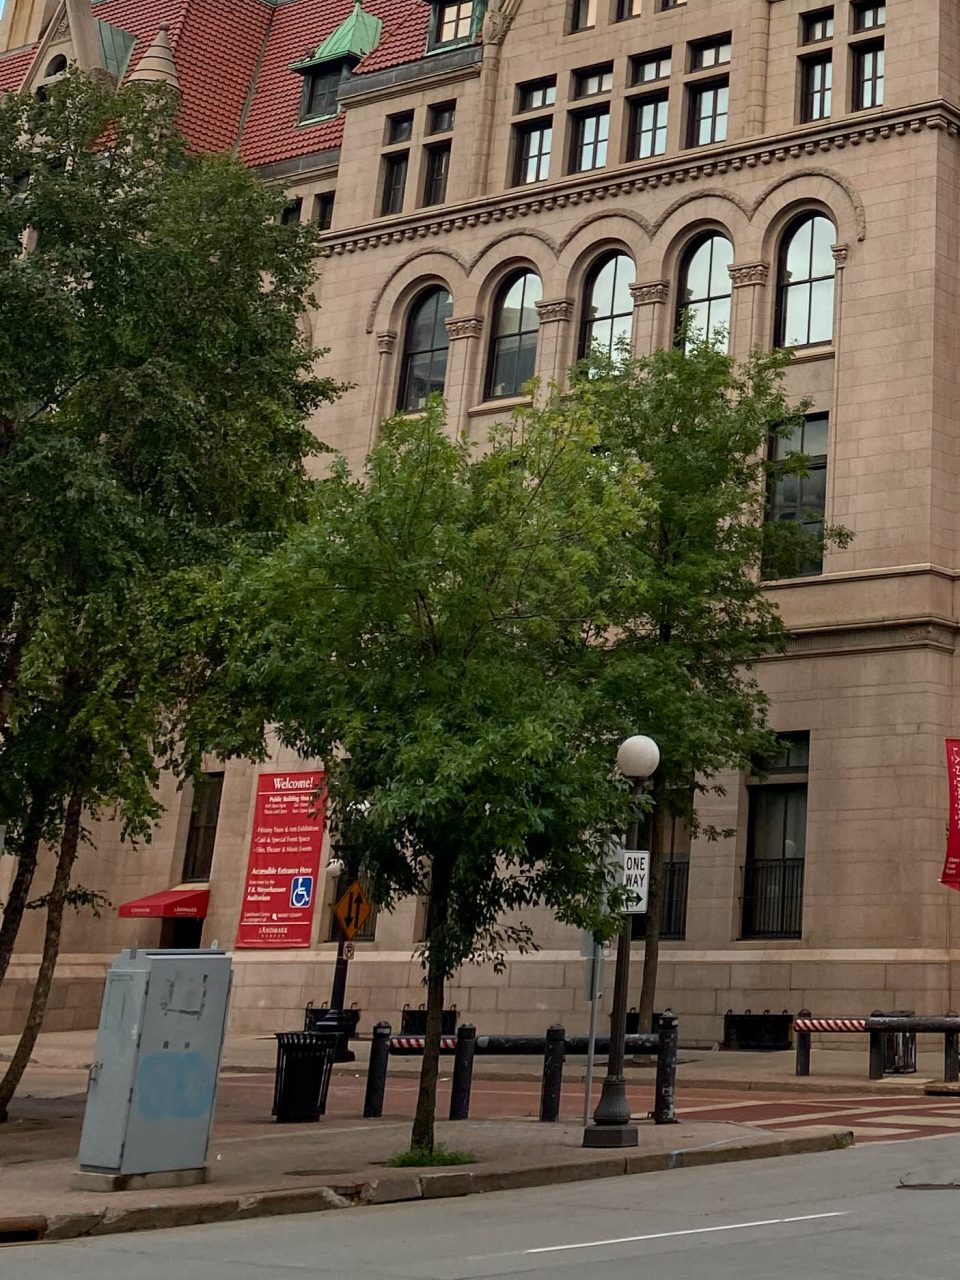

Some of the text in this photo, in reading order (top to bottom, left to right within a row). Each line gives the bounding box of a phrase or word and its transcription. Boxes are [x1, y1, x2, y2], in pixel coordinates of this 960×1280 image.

[273, 776, 314, 790] Welcome!
[299, 866, 312, 874] Here
[626, 856, 646, 871] ONE
[625, 873, 646, 888] WAY
